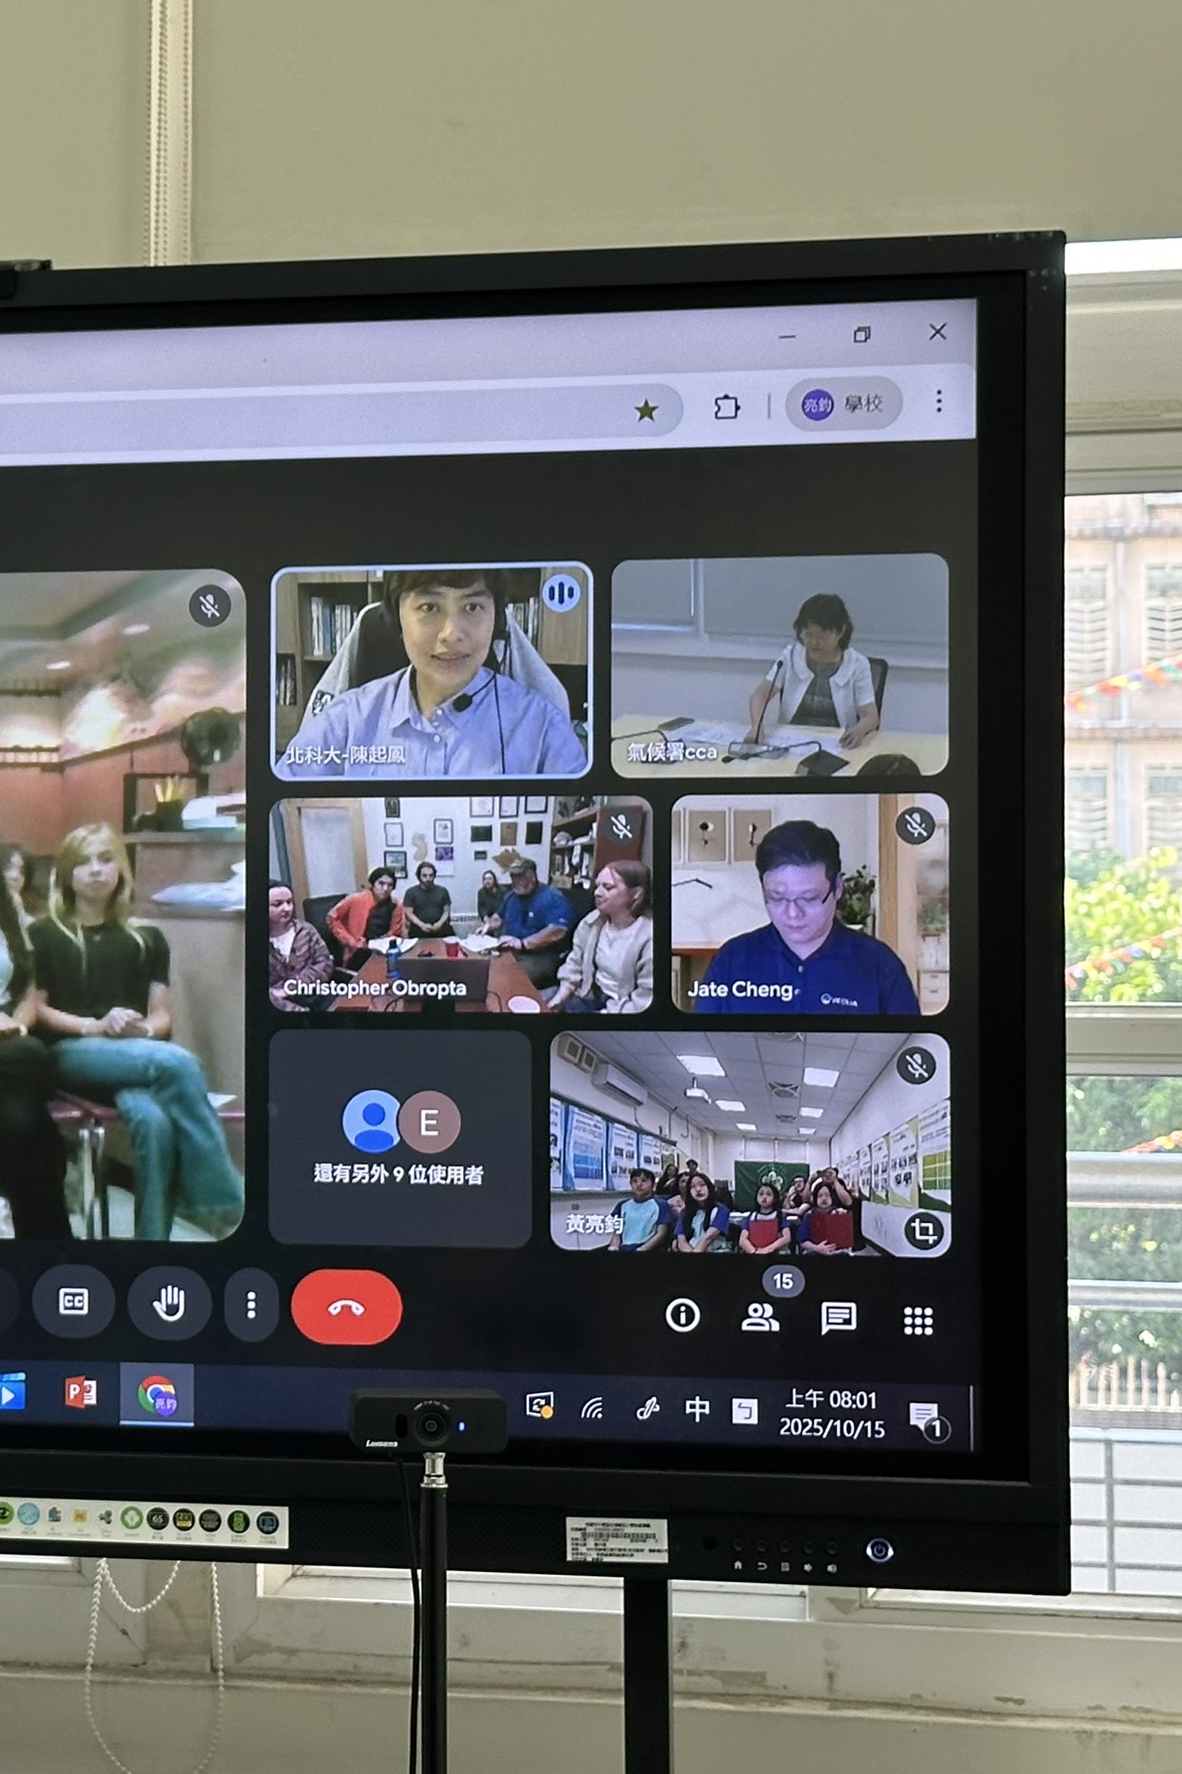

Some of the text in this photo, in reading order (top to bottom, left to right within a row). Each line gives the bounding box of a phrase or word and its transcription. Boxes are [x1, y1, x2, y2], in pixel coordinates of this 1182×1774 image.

[845, 393, 884, 413] 學校
[286, 745, 407, 765] 北科大-陳起鳳
[628, 742, 718, 762] 氣候署cca
[283, 978, 467, 998] Christopher Obropta
[687, 980, 793, 1001] Jate Cheng
[420, 1109, 439, 1136] E
[314, 1163, 484, 1185] 還有另外 9 位使用者
[773, 1273, 794, 1289] 15
[69, 1384, 80, 1400] P
[786, 1388, 876, 1410] 上午 08:01
[685, 1396, 710, 1423] 中
[780, 1418, 886, 1440] 2025/10/15
[931, 1420, 941, 1437] 1
